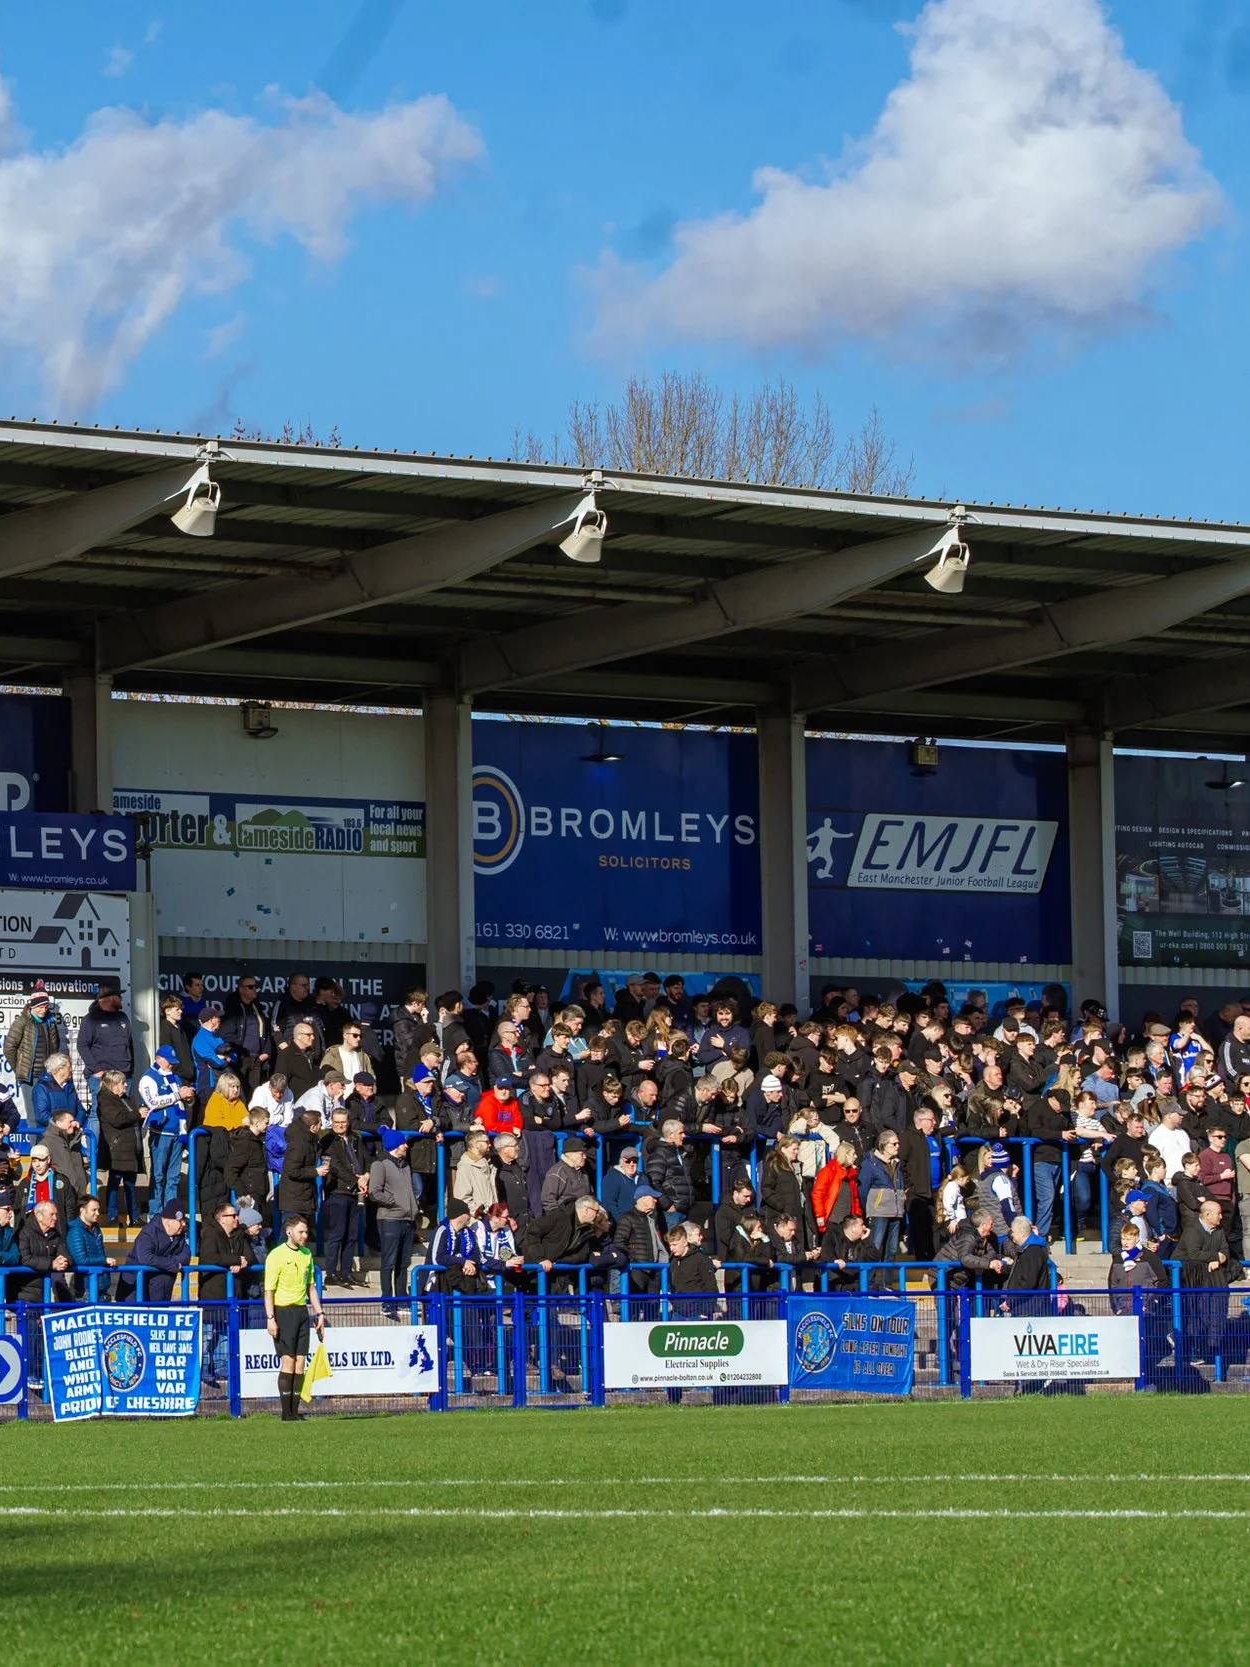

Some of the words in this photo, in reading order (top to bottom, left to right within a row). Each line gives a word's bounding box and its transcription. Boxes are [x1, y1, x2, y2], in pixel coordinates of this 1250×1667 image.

[370, 804, 384, 818] For
[386, 805, 398, 819] all
[399, 808, 424, 822] your
[213, 814, 232, 844] &
[370, 821, 394, 836] local
[396, 824, 423, 837] news
[531, 806, 755, 845] BROMLEYS
[370, 837, 388, 851] and
[389, 840, 416, 854] sport
[862, 820, 1037, 875] EMJFL
[599, 855, 691, 870] SOLICITORS
[21, 873, 109, 886] www.bromleys.co.uk
[858, 872, 877, 883] East
[880, 873, 934, 885] Manchester
[935, 875, 965, 887] Junior
[967, 876, 1004, 888] Football
[1007, 877, 1039, 891] League
[476, 923, 500, 937] 161
[505, 924, 531, 938] 330
[535, 925, 569, 940] 6821
[604, 928, 618, 941] W:
[623, 929, 756, 946] www.bromleys.co.uk
[350, 979, 383, 995] THE
[51, 1312, 168, 1333] MACCLESFIELD
[175, 1314, 194, 1327] FC
[664, 1331, 729, 1352] Pinnacle
[1014, 1334, 1099, 1355] VIVAFIRE
[65, 1345, 97, 1361] BLUE
[352, 1352, 368, 1367] UK
[371, 1351, 395, 1366] LTD.
[69, 1358, 95, 1373] AND
[155, 1356, 186, 1367] BAR
[665, 1359, 698, 1369] Electrical
[700, 1358, 729, 1370] Supplies
[1016, 1360, 1030, 1368] Wet
[1037, 1360, 1049, 1370] Dry
[1050, 1359, 1065, 1368] Riser
[1067, 1359, 1099, 1368] Specialists
[156, 1369, 185, 1380] NOT
[640, 1373, 714, 1382] www.pinnacle-bolton.co.uk
[66, 1383, 101, 1398] ARMY
[156, 1382, 186, 1394] VAR
[126, 1396, 196, 1410] CHESHIRE
